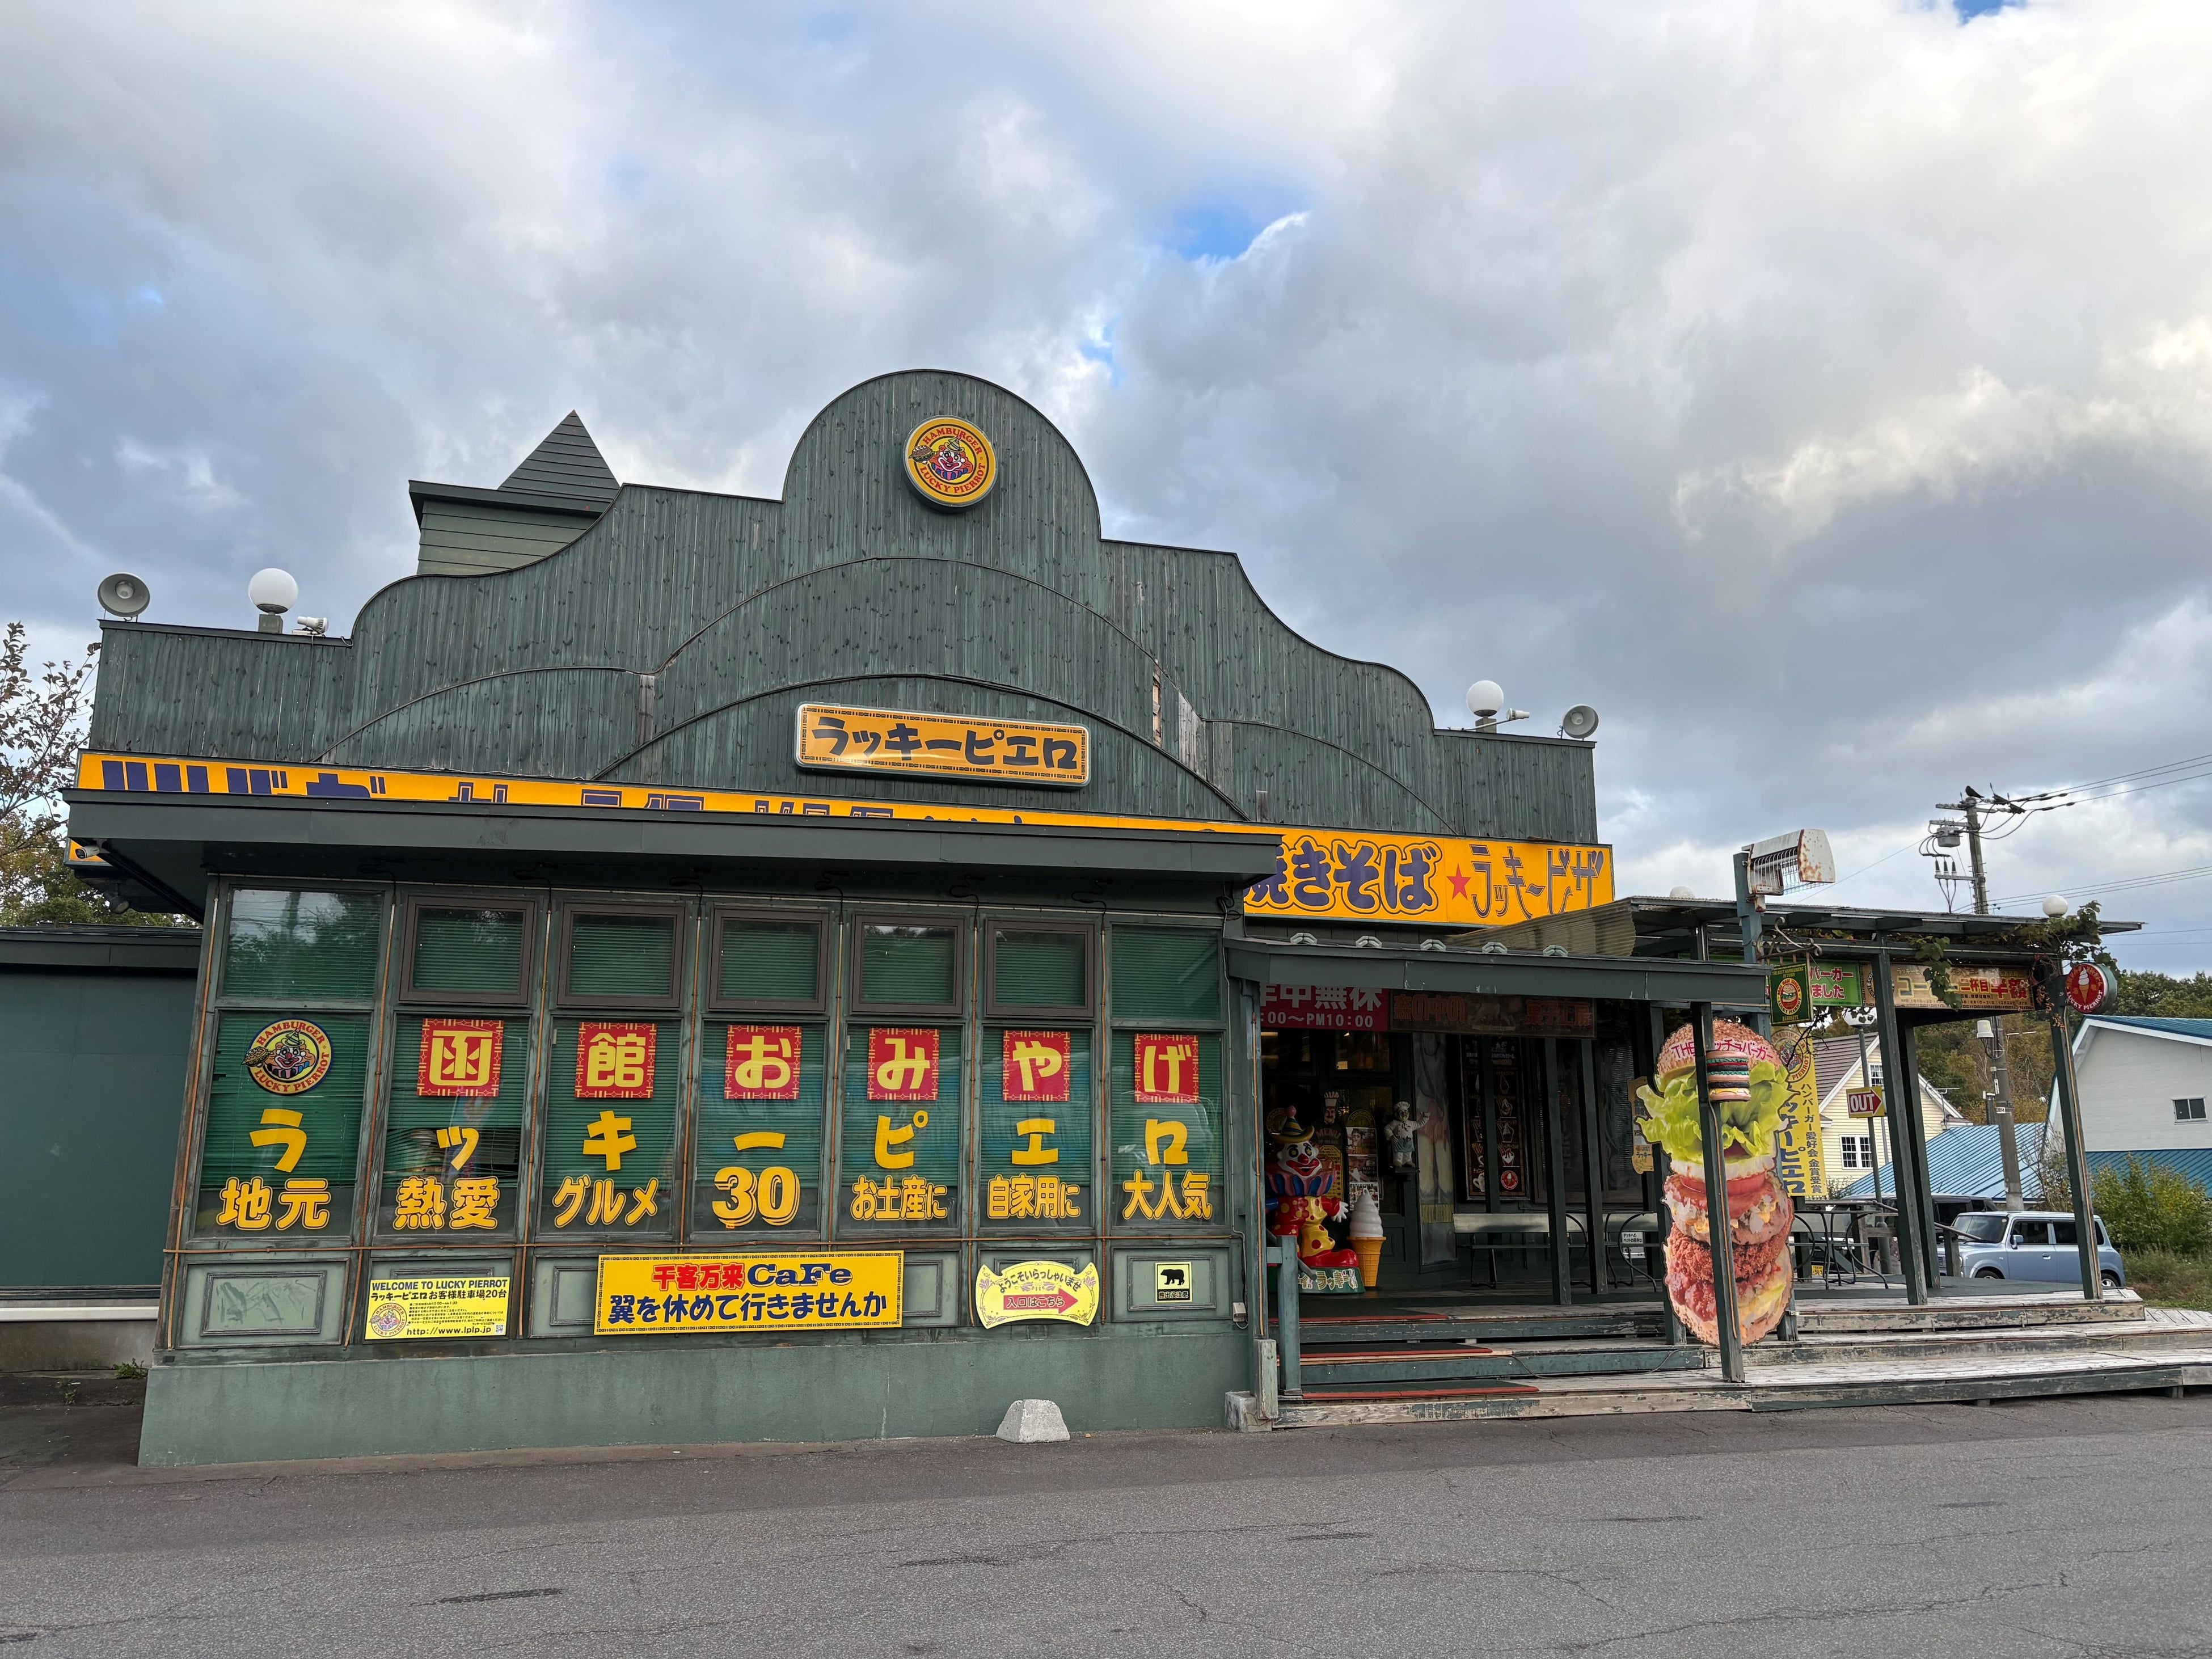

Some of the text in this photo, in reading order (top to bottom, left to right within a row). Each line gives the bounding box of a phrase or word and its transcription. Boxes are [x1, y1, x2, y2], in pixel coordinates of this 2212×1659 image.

[922, 427, 982, 454] HAMBURGER
[919, 463, 985, 493] LUCKY PIERROT
[812, 716, 1077, 770] ラッキーピエロ
[1471, 844, 1605, 919] ラッキーピザ
[1809, 966, 1854, 982] バーガー
[1811, 983, 1846, 999] ました
[2066, 990, 2103, 1010] LUCKY PIERROT
[256, 1021, 325, 1045] HAMBURGER
[255, 1052, 330, 1092] LUCKY PIERROT
[1792, 1054, 1809, 1080] PIERROT
[1850, 1094, 1875, 1112] OUT
[1780, 1086, 1806, 1193] ッキーピエロ
[216, 1167, 1213, 1231] 地元 熱愛 グルメ 30 お土産に 自家用に 大人気
[372, 1279, 508, 1291] WELCOME TO LUCKY PIERROT
[652, 1263, 853, 1291] 千客万来 CaFe
[998, 1268, 1082, 1294] ようこそいらっしゃいませ
[608, 1291, 887, 1324] 翼を休めて行きませんか
[1006, 1295, 1065, 1309] 入口はこちら
[407, 1326, 491, 1336] http://www.lplp.jp
